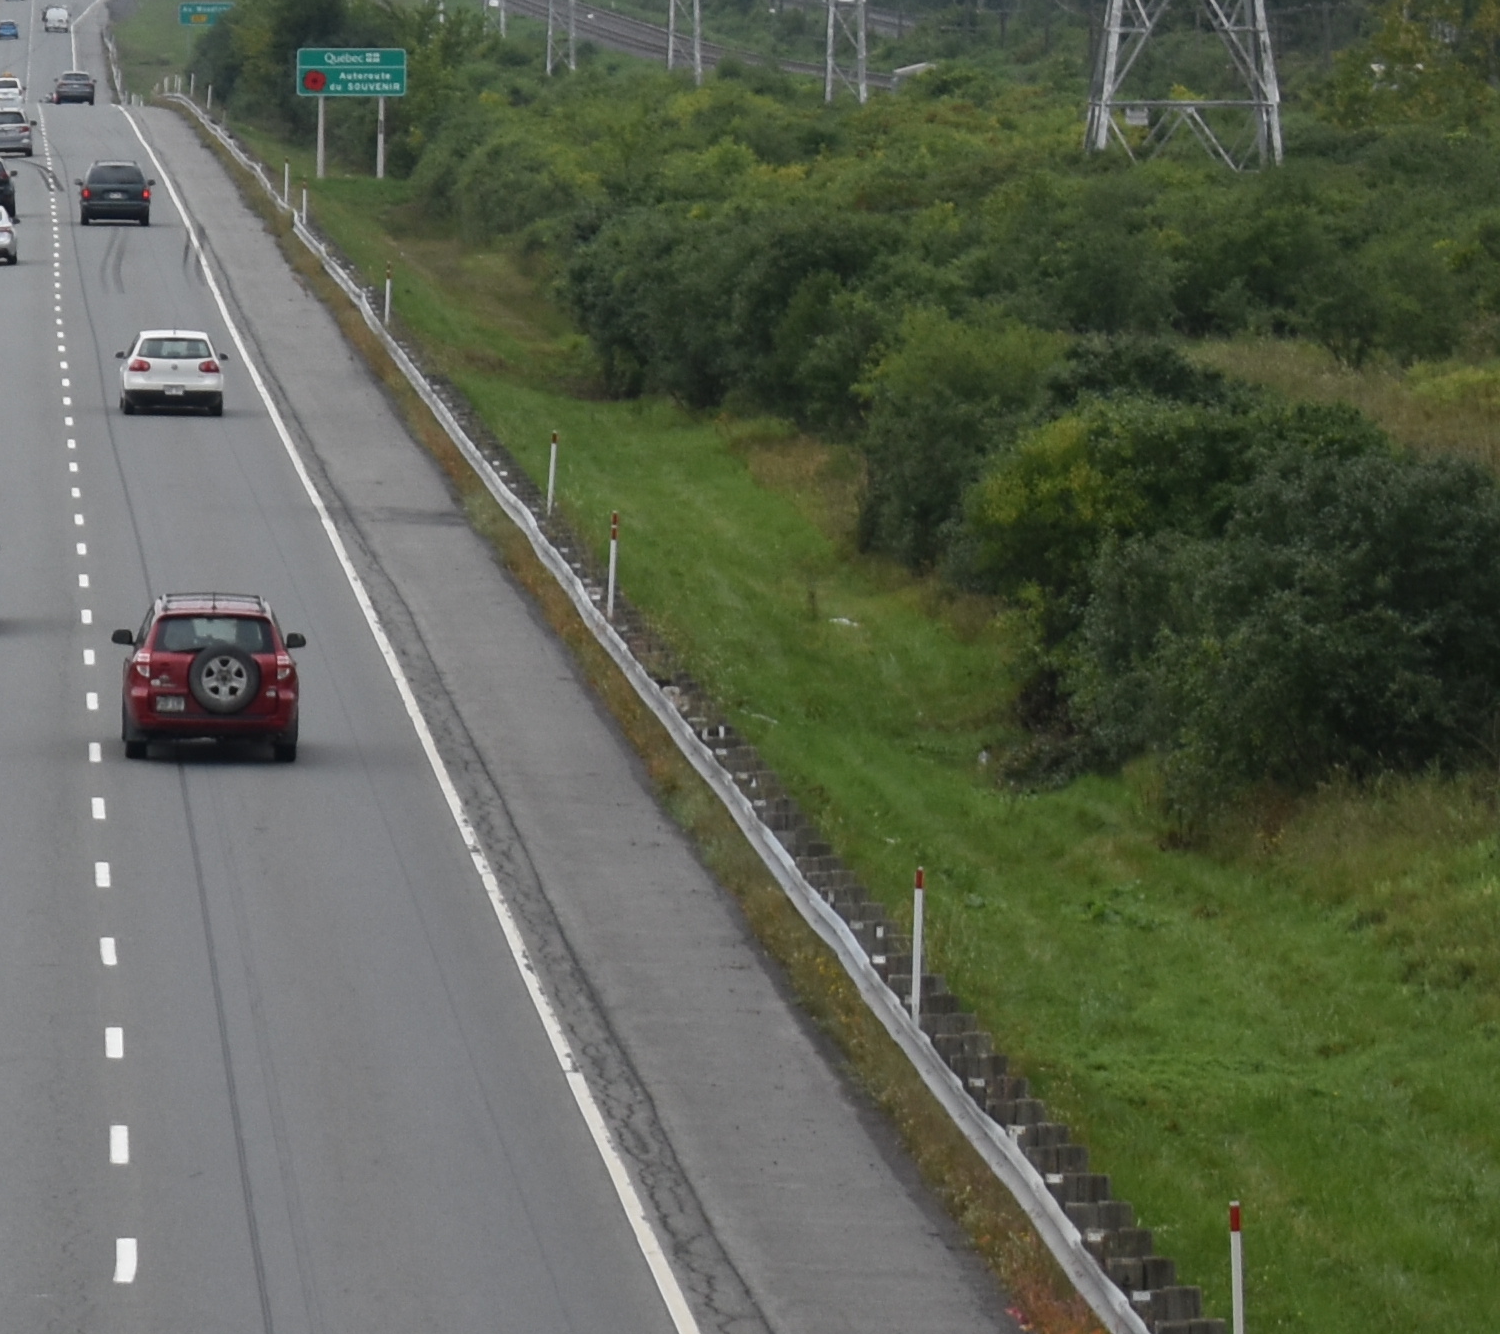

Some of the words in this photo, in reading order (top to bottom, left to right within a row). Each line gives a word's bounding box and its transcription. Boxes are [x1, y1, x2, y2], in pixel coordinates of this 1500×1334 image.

[324, 52, 364, 64] Québec
[339, 72, 391, 80] Autoroute
[329, 82, 342, 91] du
[347, 82, 400, 91] SOUVENIR
